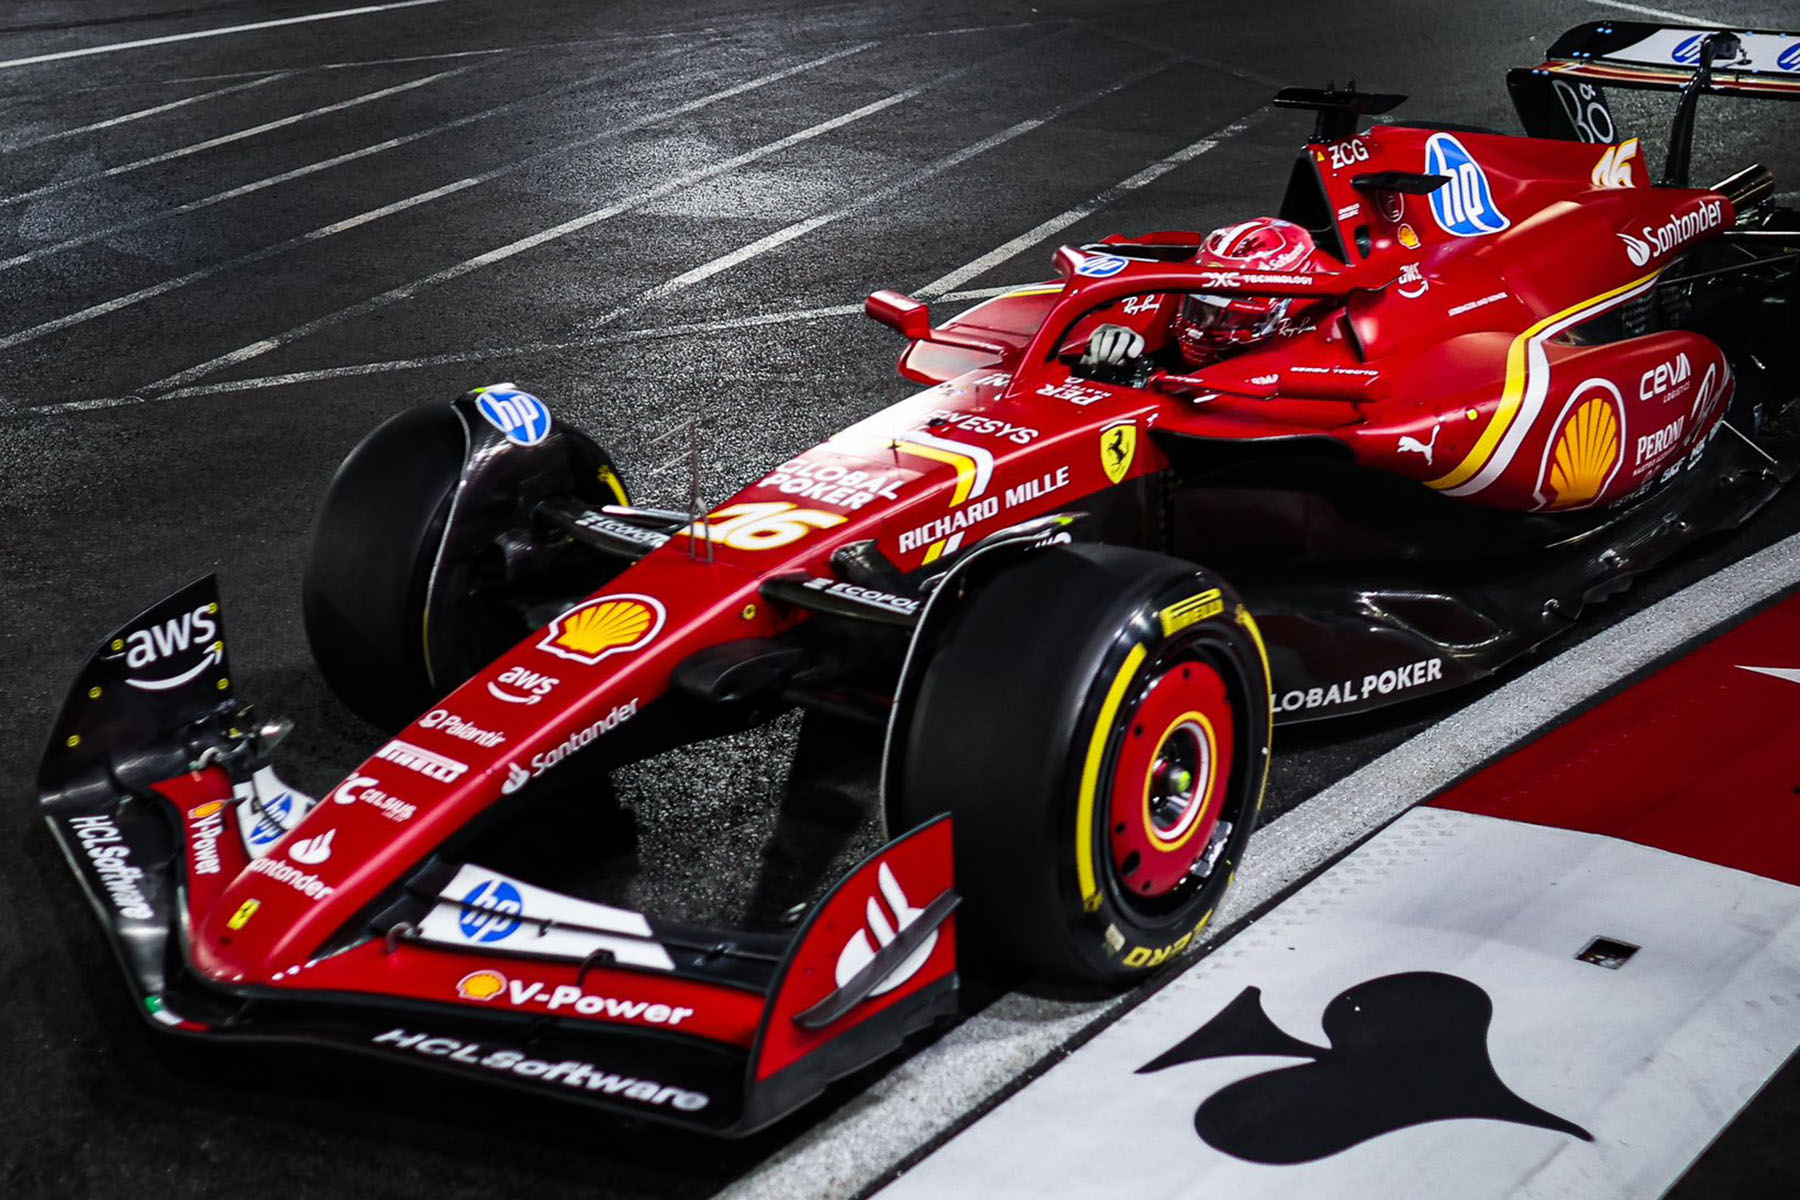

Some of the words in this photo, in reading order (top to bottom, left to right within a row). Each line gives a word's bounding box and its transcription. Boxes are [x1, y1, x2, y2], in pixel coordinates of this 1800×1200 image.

[1427, 133, 1510, 235] hp
[1591, 137, 1637, 189] 16
[1643, 199, 1722, 258] Santander
[1243, 274, 1313, 286] TECHNOLOGY
[475, 389, 551, 445] hp
[1635, 415, 1685, 466] PERONI
[757, 471, 878, 511] POKER
[776, 458, 908, 500] GLOBAL
[675, 501, 849, 551] 16
[899, 495, 999, 554] RICHARD
[1005, 464, 1070, 508] MILLE
[126, 604, 217, 668] aws
[497, 666, 560, 695] aws
[1270, 684, 1357, 713] LOBAL
[1360, 657, 1443, 699] POKER
[439, 716, 506, 748] Palantir
[531, 697, 639, 777] Santander
[375, 739, 469, 784] PIRELLI
[249, 856, 335, 900] antander
[459, 879, 523, 942] hp
[508, 979, 694, 1025] V-Power
